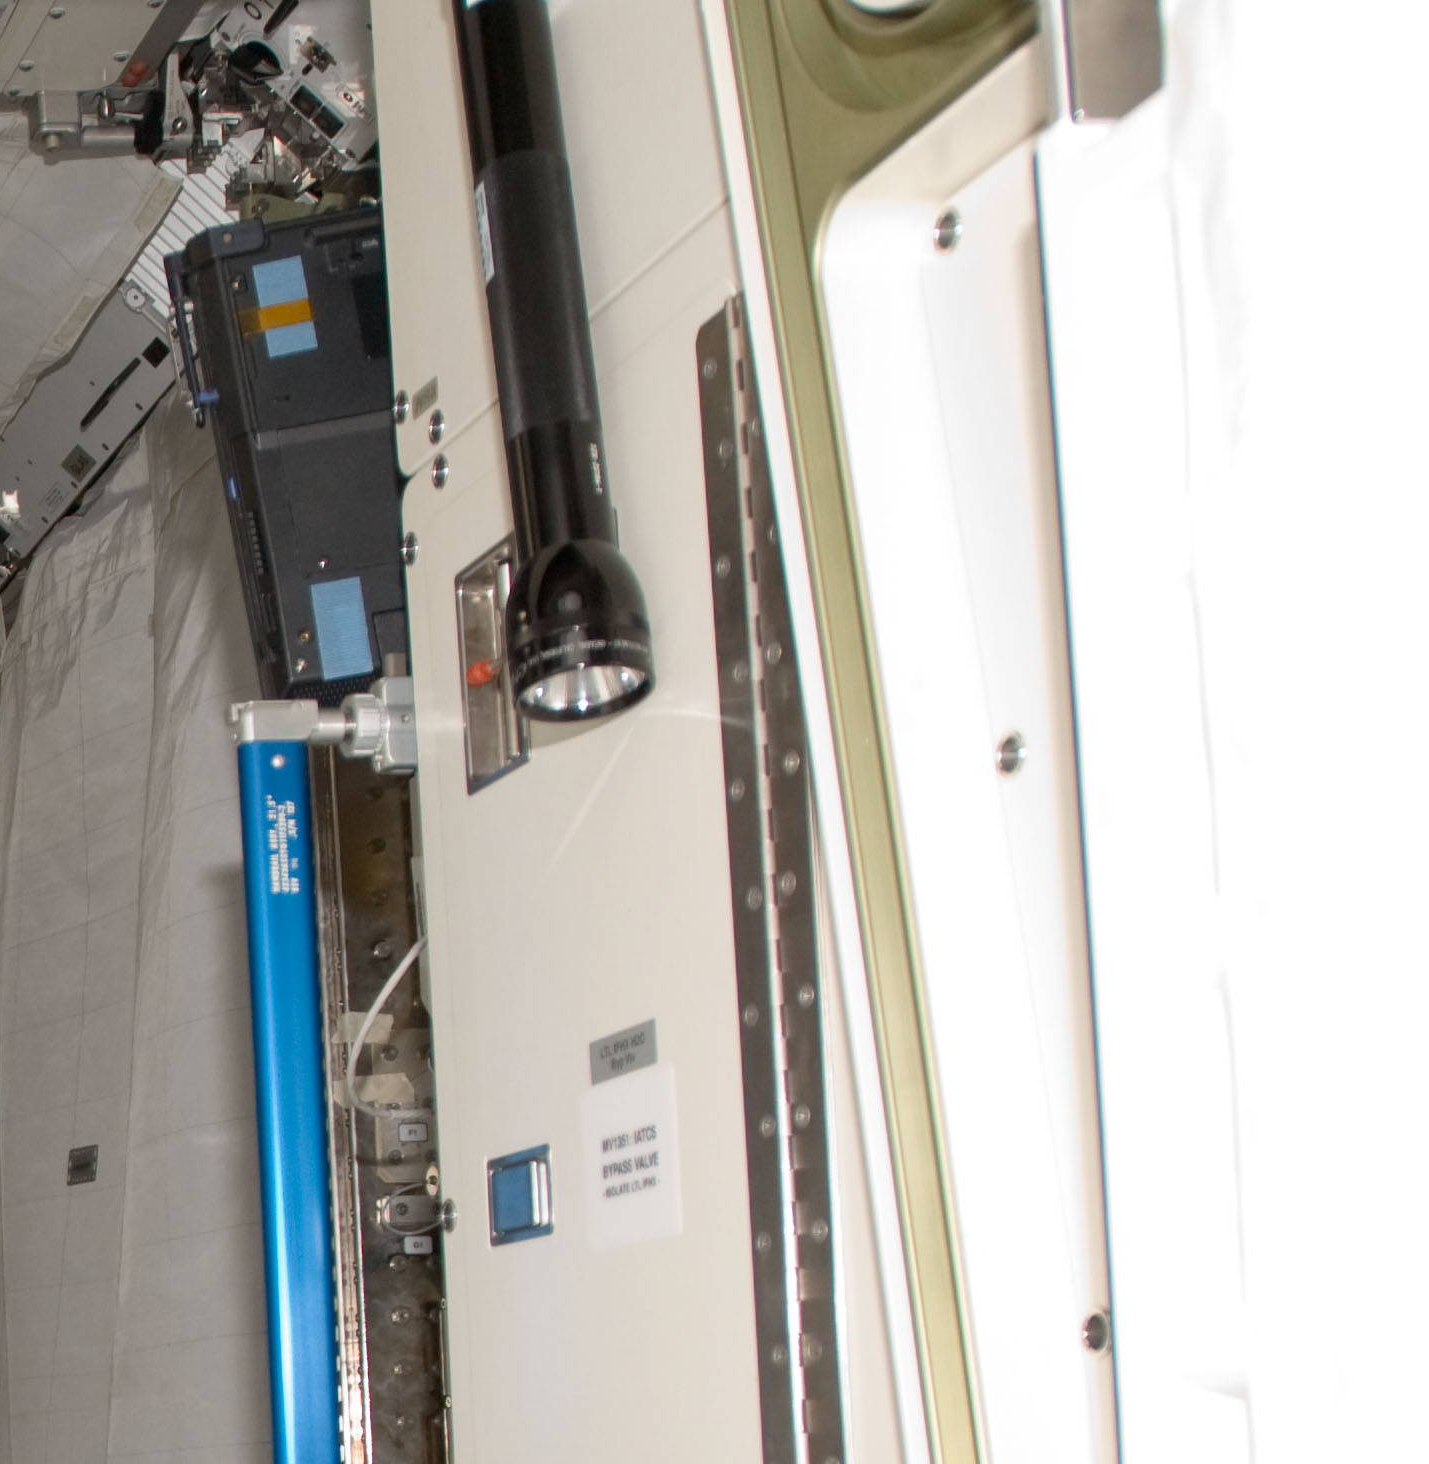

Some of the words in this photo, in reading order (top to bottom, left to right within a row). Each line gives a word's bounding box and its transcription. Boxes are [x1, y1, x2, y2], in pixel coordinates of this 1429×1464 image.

[634, 1124, 657, 1146] IATCS
[602, 1158, 633, 1180] BYPASS
[634, 1151, 660, 1172] VALVE
